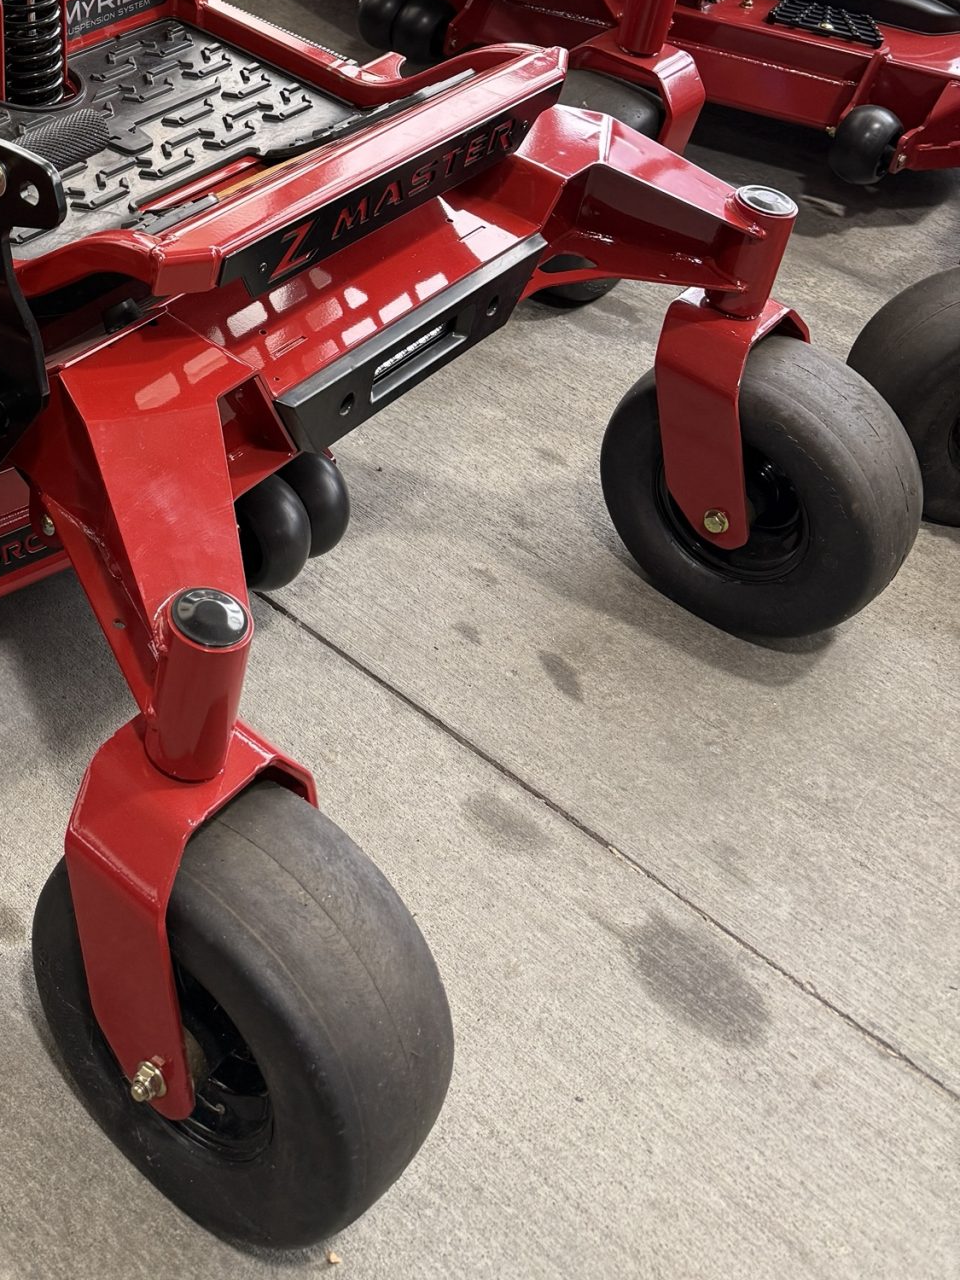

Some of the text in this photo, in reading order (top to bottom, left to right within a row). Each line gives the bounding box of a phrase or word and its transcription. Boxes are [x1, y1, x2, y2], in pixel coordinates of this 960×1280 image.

[67, 11, 116, 35] USPENSION
[268, 120, 517, 283] Z MASTER
